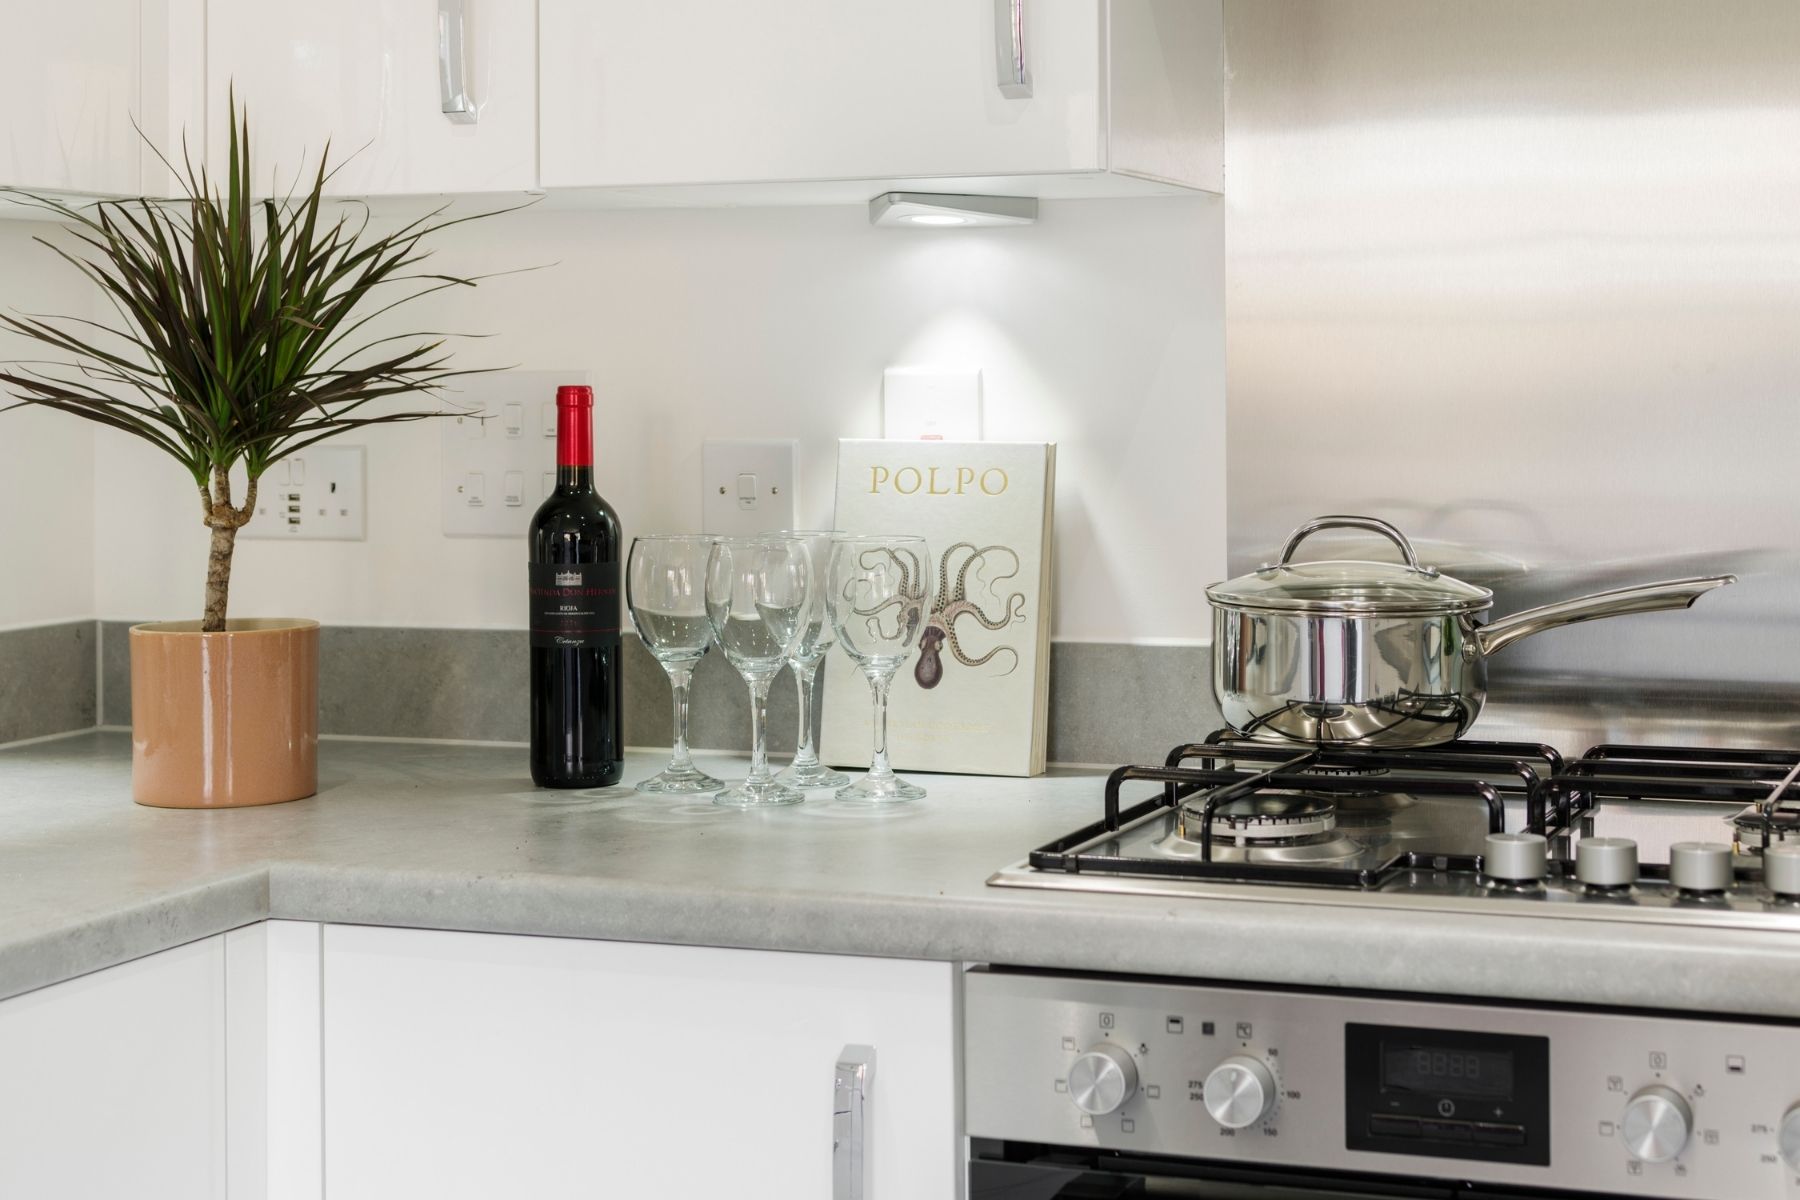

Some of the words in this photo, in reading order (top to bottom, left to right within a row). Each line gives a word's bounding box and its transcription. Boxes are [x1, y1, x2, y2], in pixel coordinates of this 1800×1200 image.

[869, 466, 1009, 496] POLPO
[1268, 1048, 1279, 1057] 50
[1188, 1080, 1203, 1089] 275
[1287, 1091, 1301, 1099] 100
[1220, 1127, 1236, 1136] 200
[1264, 1128, 1278, 1137] 150
